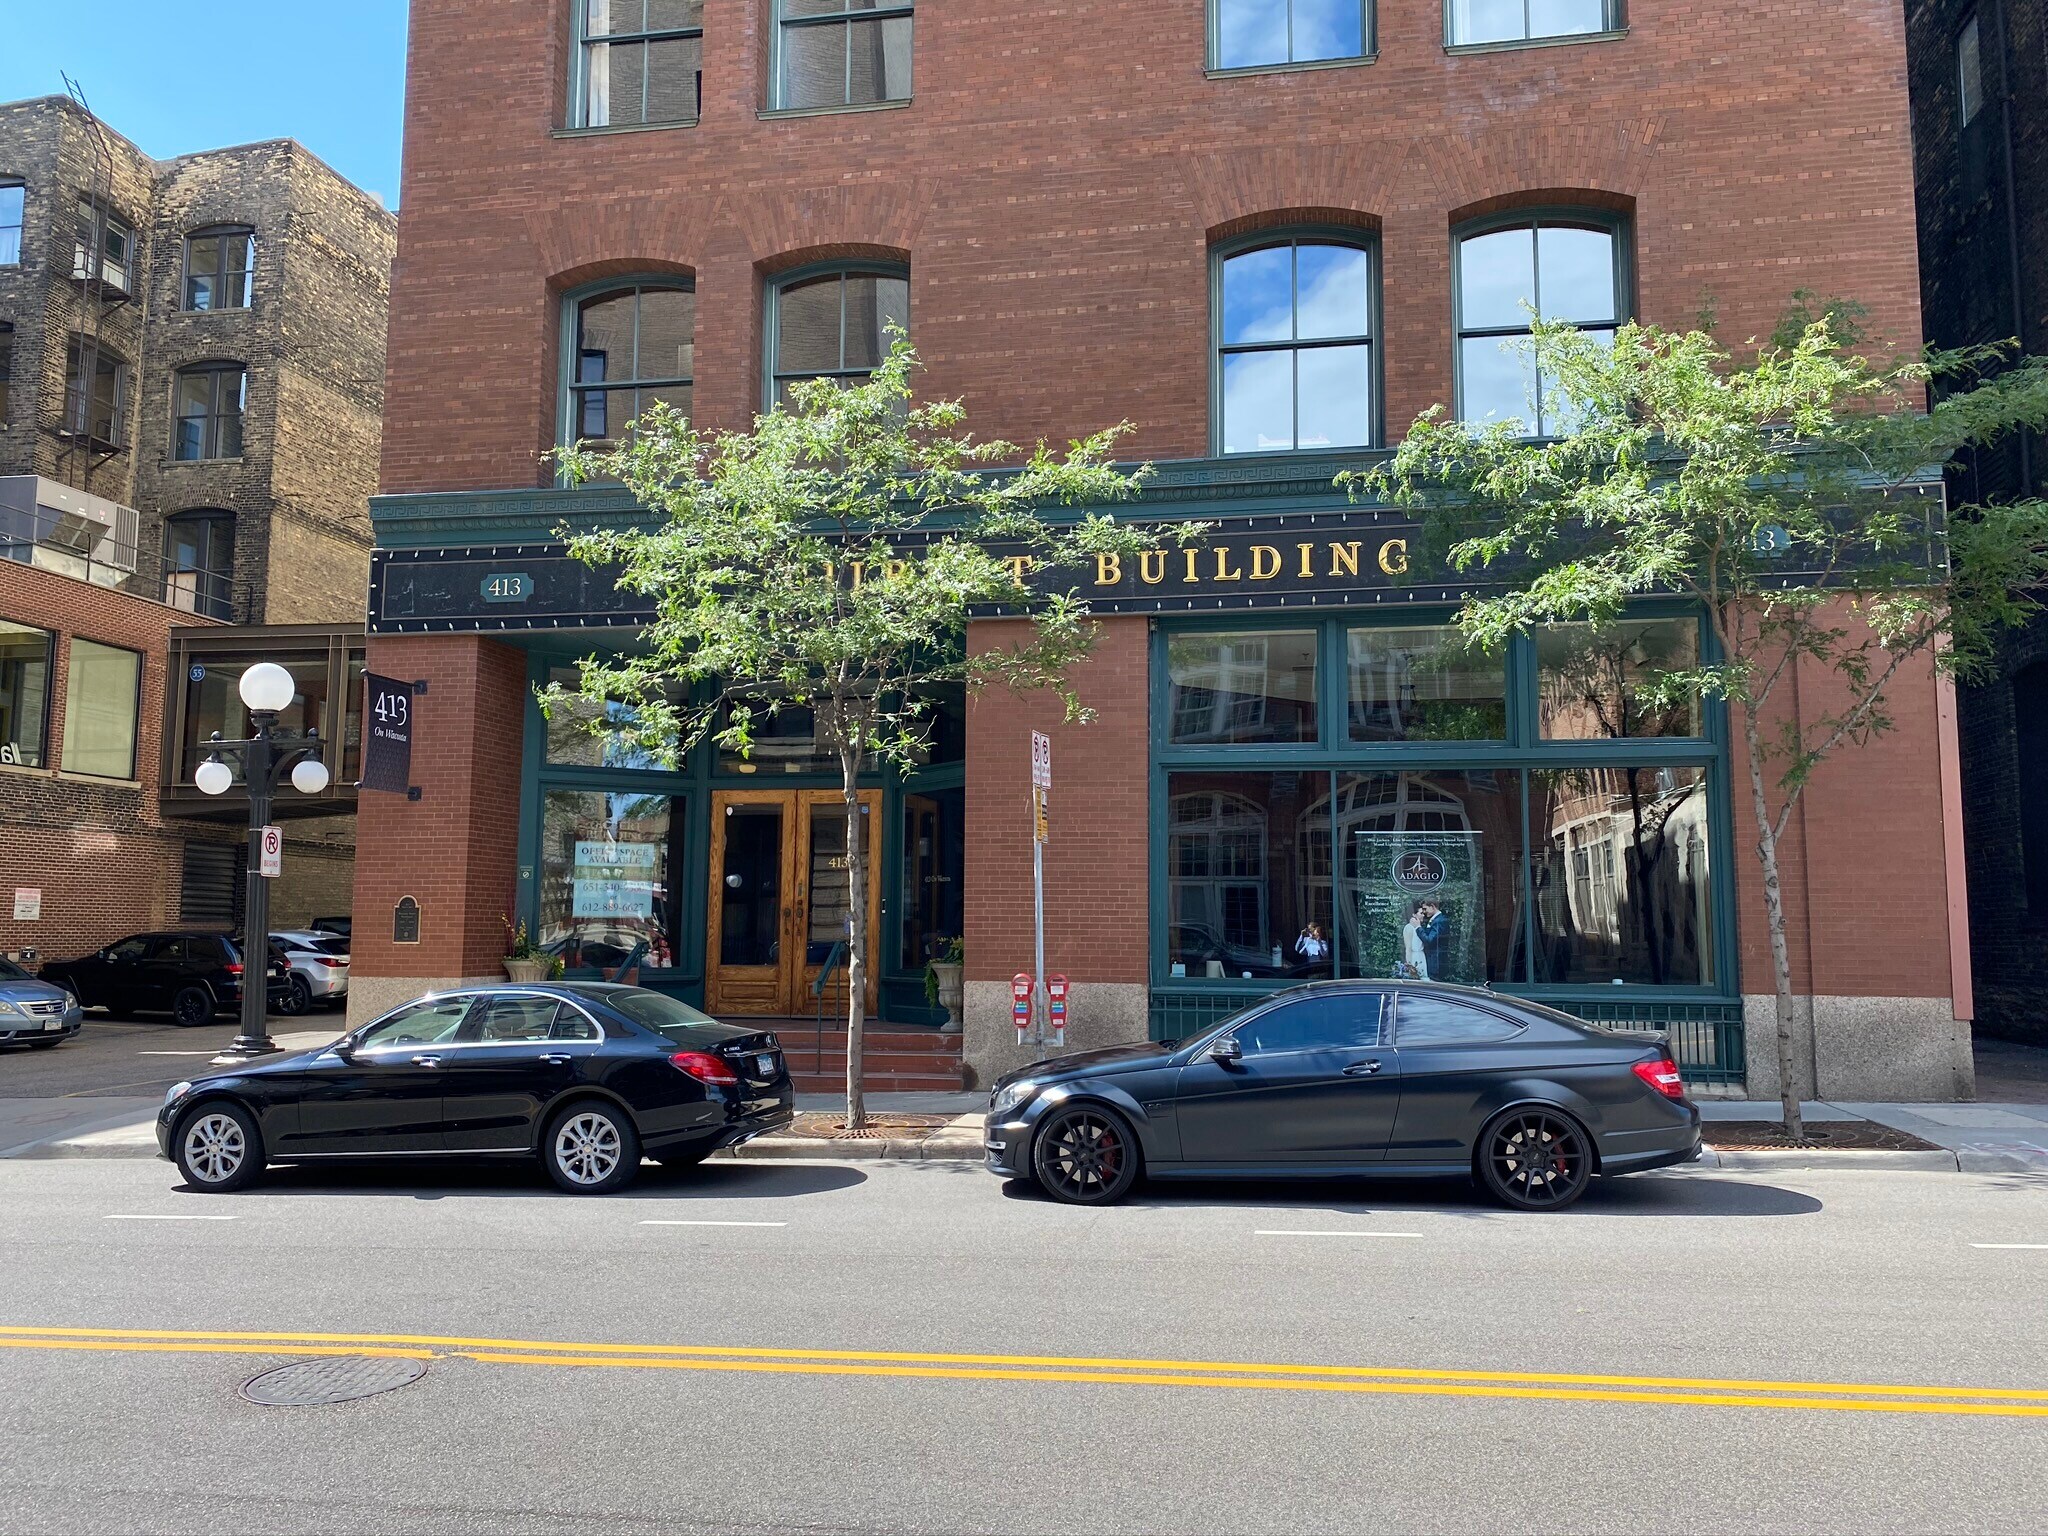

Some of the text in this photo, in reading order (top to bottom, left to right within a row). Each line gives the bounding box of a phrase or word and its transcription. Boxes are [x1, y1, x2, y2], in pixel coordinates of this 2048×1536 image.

[1742, 530, 1775, 551] 13
[1094, 539, 1407, 586] BUILDING
[488, 577, 521, 597] 413
[192, 668, 203, 678] 55
[374, 691, 408, 726] 413
[374, 726, 384, 737] On
[620, 848, 648, 856] SPACE
[828, 857, 849, 868] 413
